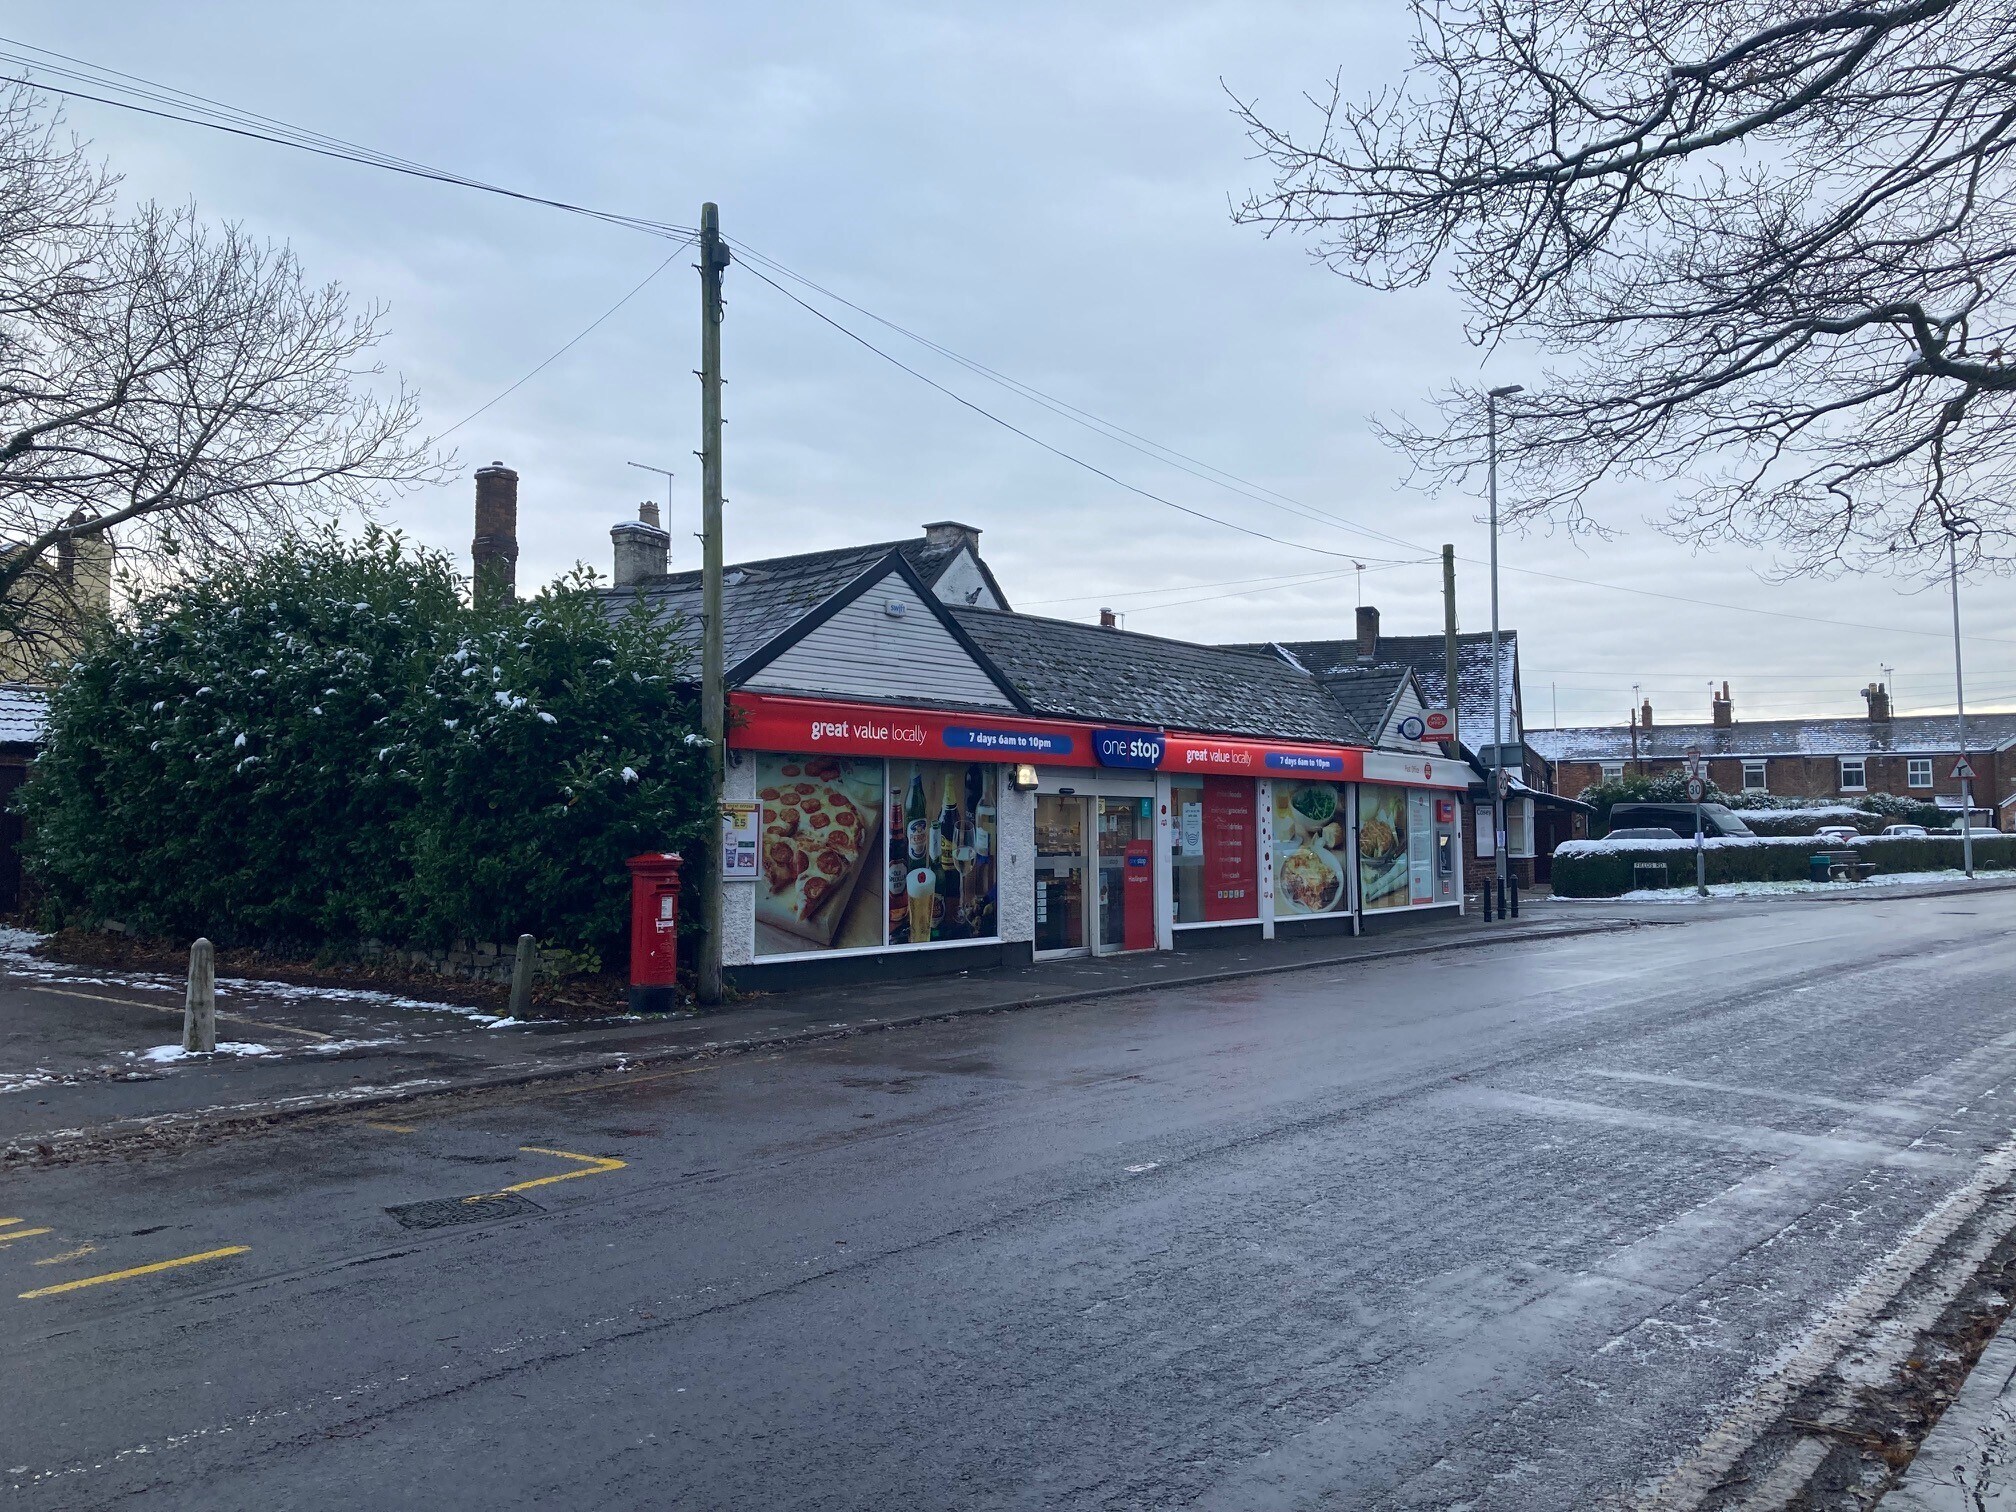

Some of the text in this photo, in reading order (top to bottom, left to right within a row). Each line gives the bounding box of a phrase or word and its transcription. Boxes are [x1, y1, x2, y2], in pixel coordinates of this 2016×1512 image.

[811, 720, 927, 746] great value locally
[969, 732, 1051, 749] 7 days 6am to 10pm
[1102, 738, 1159, 763] one stop
[1186, 749, 1252, 766] great value locally
[1280, 756, 1284, 764] 7
[1285, 757, 1297, 767] days
[1298, 758, 1308, 766] 6am
[1316, 758, 1330, 769] 10pm
[1500, 776, 1506, 790] 20
[1689, 784, 1700, 795] 30
[735, 818, 746, 827] £5
